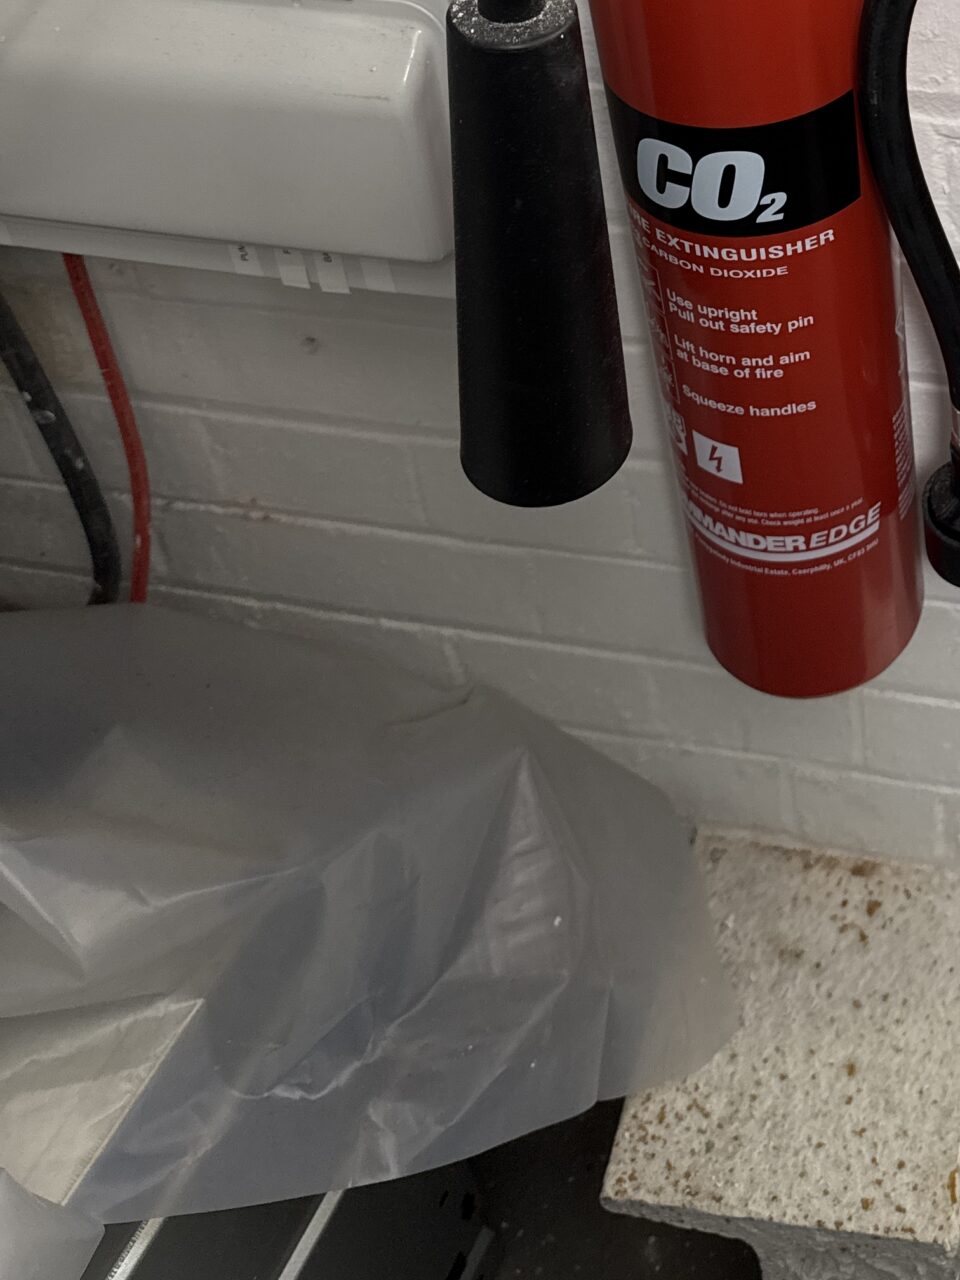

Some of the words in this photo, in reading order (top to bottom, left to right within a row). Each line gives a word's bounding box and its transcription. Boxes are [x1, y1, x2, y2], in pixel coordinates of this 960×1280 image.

[643, 236, 704, 274] CARBON
[709, 265, 789, 279] DIOXIDE
[655, 228, 836, 262] EXTINGUISHER
[666, 288, 693, 310] Use
[697, 303, 758, 324] upright
[668, 301, 694, 323] Pull
[699, 317, 726, 332] out
[729, 321, 782, 336] safety
[787, 314, 814, 333] pin
[674, 334, 695, 355] Lift
[699, 345, 737, 366] horn
[741, 353, 774, 367] and
[779, 350, 811, 366] aim
[676, 348, 689, 364] at
[692, 354, 729, 377] base
[733, 367, 751, 379] of
[755, 367, 784, 379] fire
[682, 384, 745, 416] Squeeze
[749, 399, 817, 417] handles
[808, 500, 882, 549] EDGE
